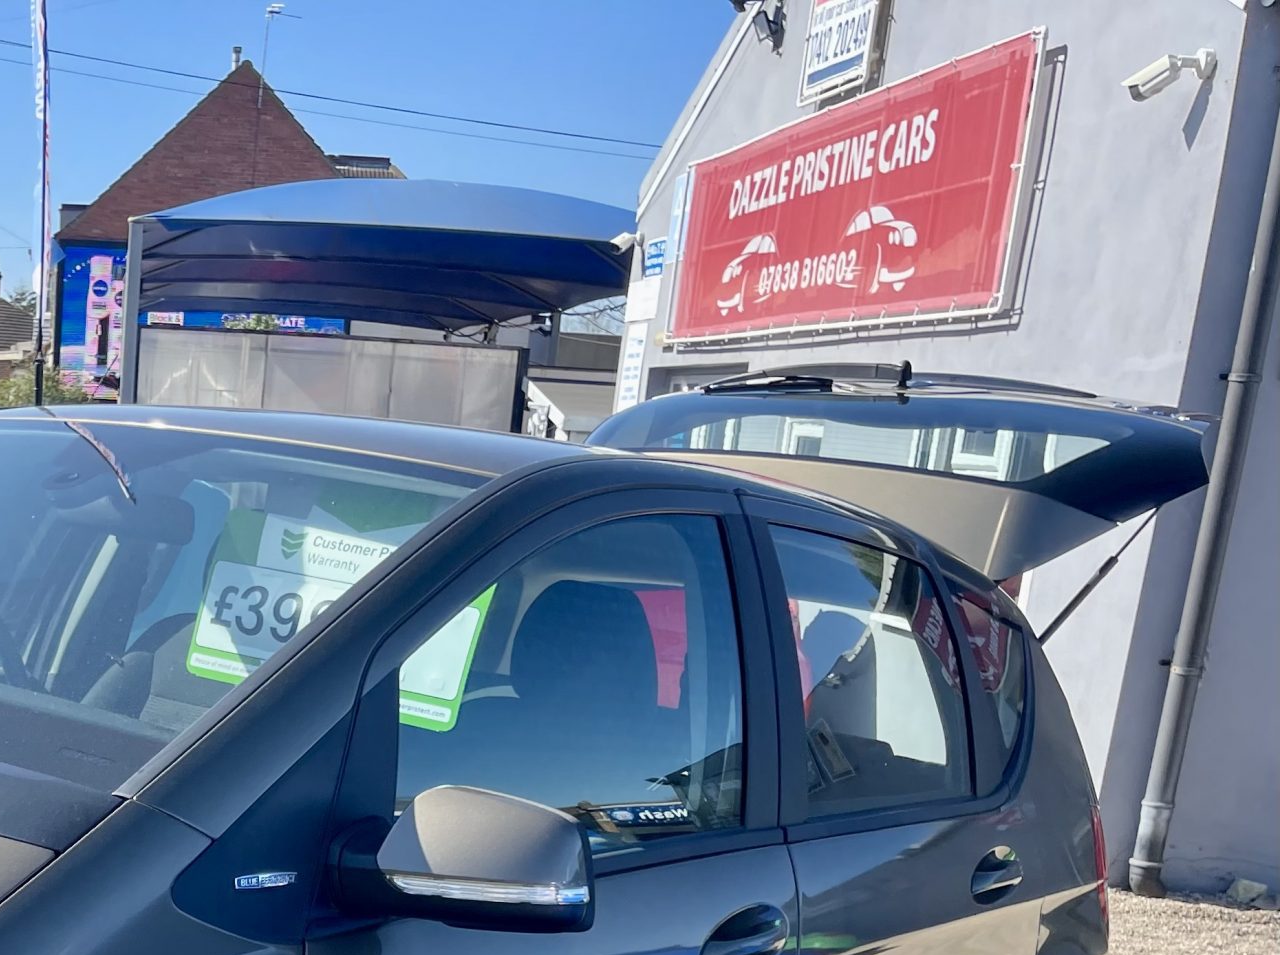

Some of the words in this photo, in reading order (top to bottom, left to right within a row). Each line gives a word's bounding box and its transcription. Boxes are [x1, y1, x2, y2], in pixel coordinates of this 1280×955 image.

[729, 160, 791, 219] DAZZLE
[789, 130, 878, 200] PRISTINE
[878, 109, 939, 173] CARS
[758, 260, 800, 296] 07838
[313, 535, 378, 557] Customer
[307, 552, 361, 574] Warranty
[240, 877, 259, 887] BLUE
